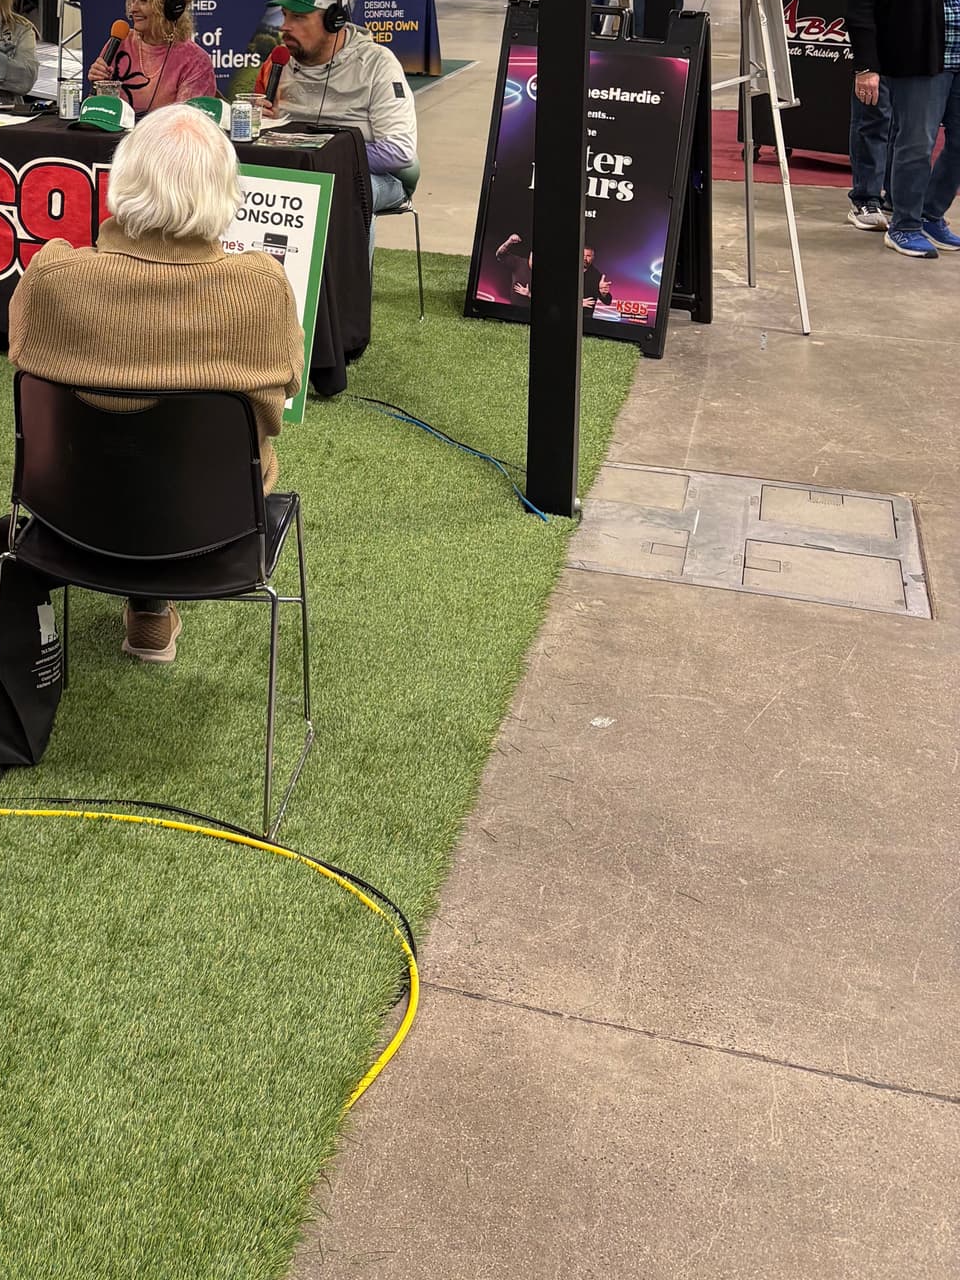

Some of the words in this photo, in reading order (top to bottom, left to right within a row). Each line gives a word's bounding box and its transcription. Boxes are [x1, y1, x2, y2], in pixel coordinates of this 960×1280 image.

[191, 0, 217, 11] HED
[364, 1, 390, 9] DESIGN
[364, 10, 404, 18] CONFIGURE
[365, 21, 393, 31] YOUR
[395, 21, 418, 31] OWN
[202, 27, 222, 46] of
[372, 32, 392, 42] HED
[211, 49, 261, 68] ilders
[805, 45, 839, 62] Raising
[843, 48, 854, 60] In
[587, 87, 660, 104] esHardie
[586, 145, 633, 175] ter
[585, 176, 634, 202] urs
[242, 191, 276, 207] YOU
[280, 195, 302, 210] TO
[236, 208, 304, 229] ONSORS
[616, 301, 647, 315] KS95
